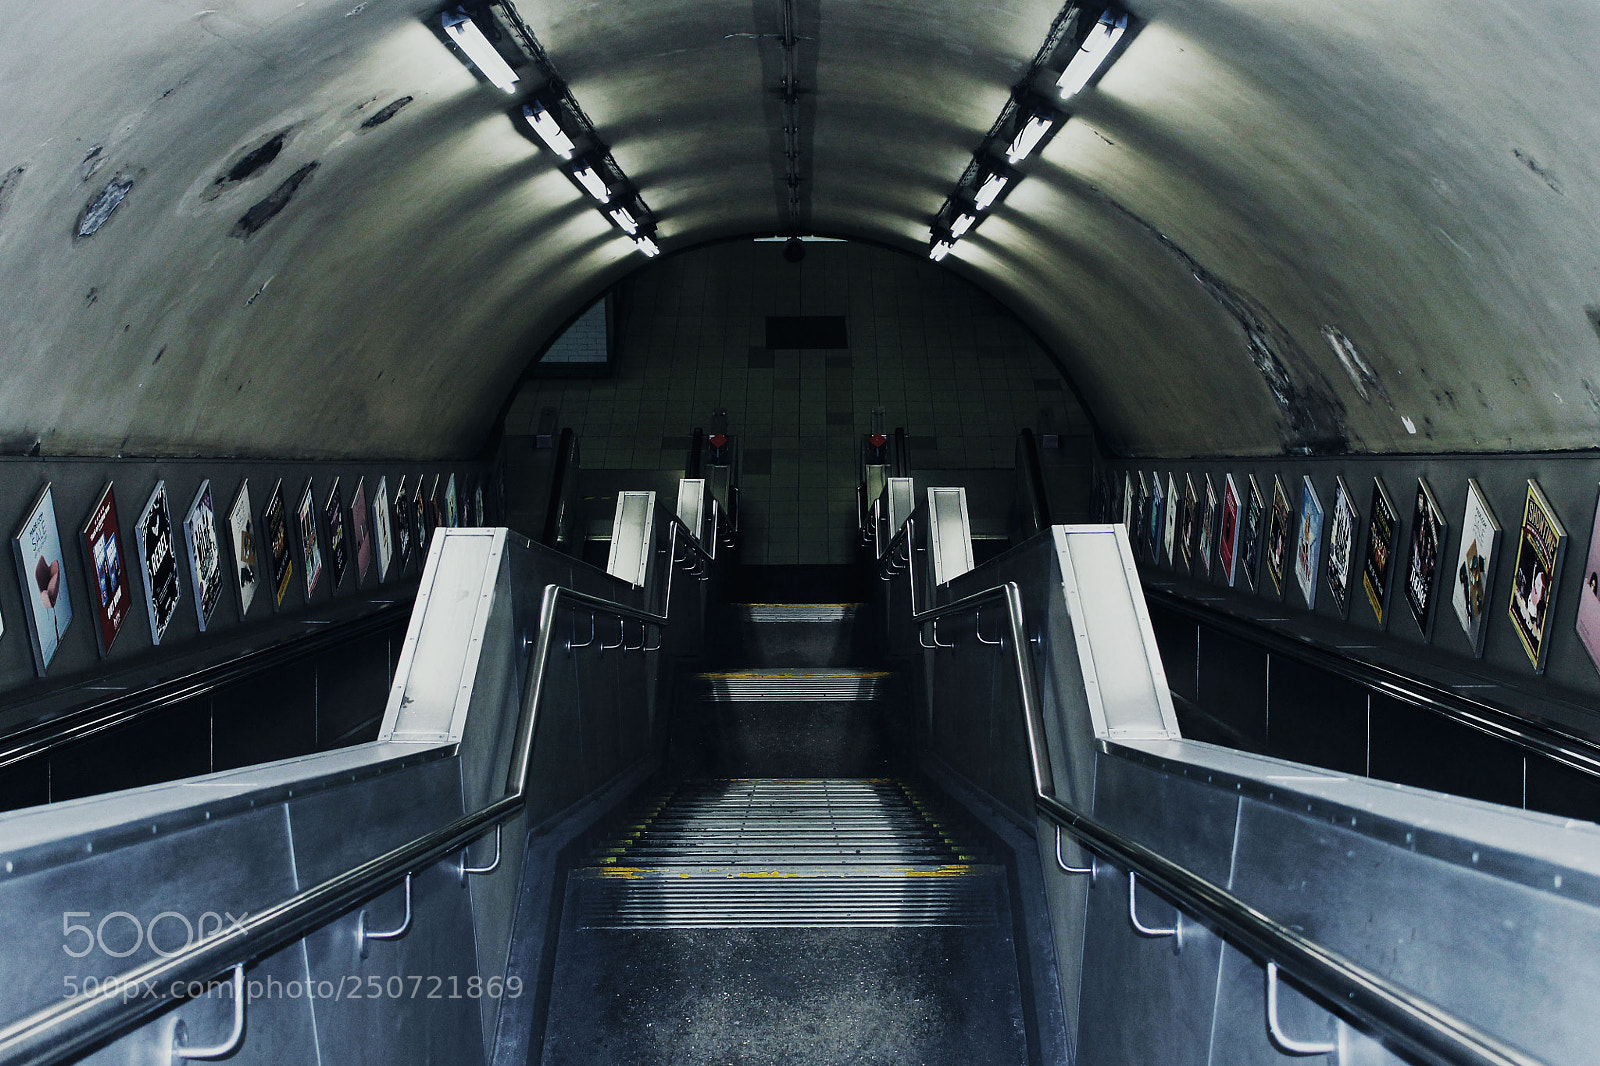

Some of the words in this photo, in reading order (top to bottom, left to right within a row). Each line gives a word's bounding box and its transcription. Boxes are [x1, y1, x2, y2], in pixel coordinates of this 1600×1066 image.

[31, 519, 47, 551] SALE
[1528, 501, 1556, 560] SHOWTIME
[151, 531, 168, 575] REBEL
